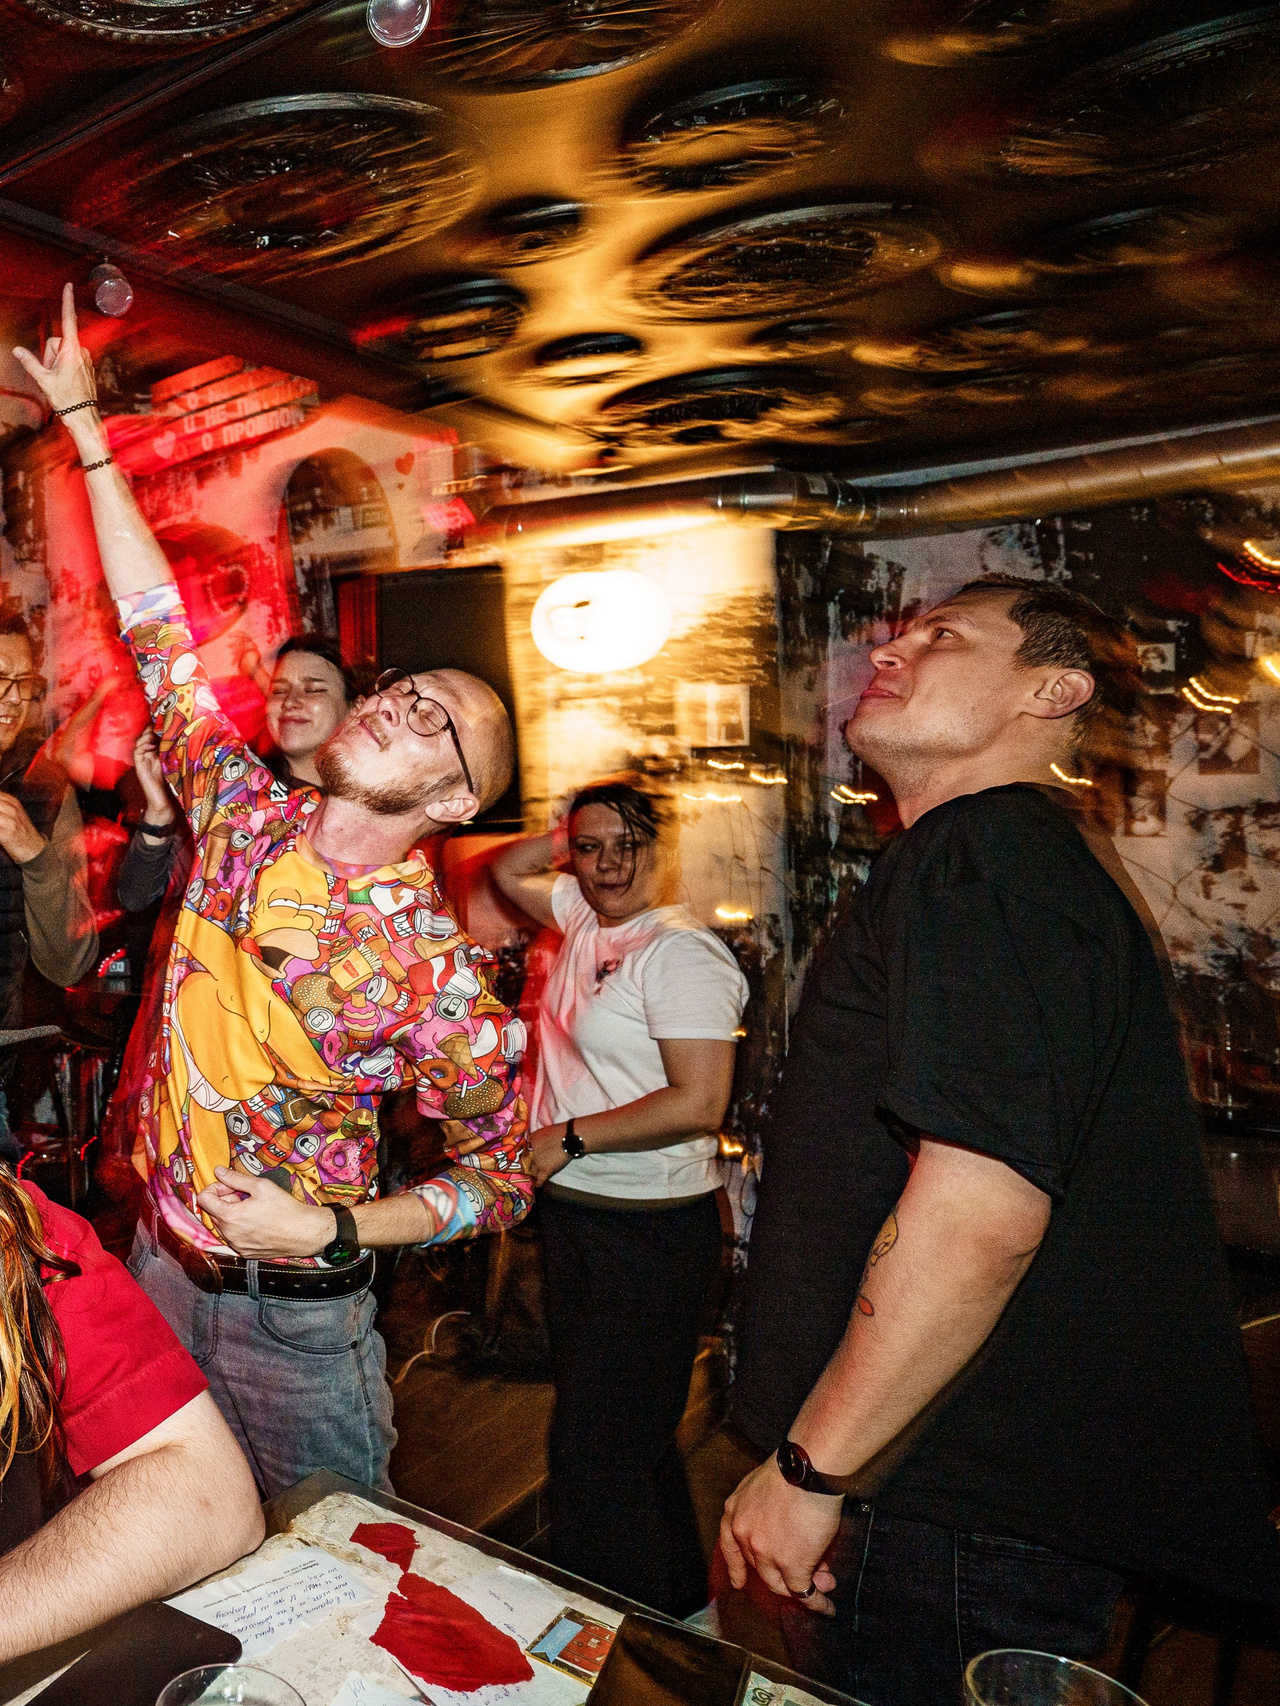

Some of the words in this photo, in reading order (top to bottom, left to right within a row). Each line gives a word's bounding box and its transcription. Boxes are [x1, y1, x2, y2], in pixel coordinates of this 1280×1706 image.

[392, 912, 415, 938] Duff
[246, 1096, 267, 1112] uff
[267, 1143, 286, 1158] Duff
[288, 1593, 297, 1602] И
